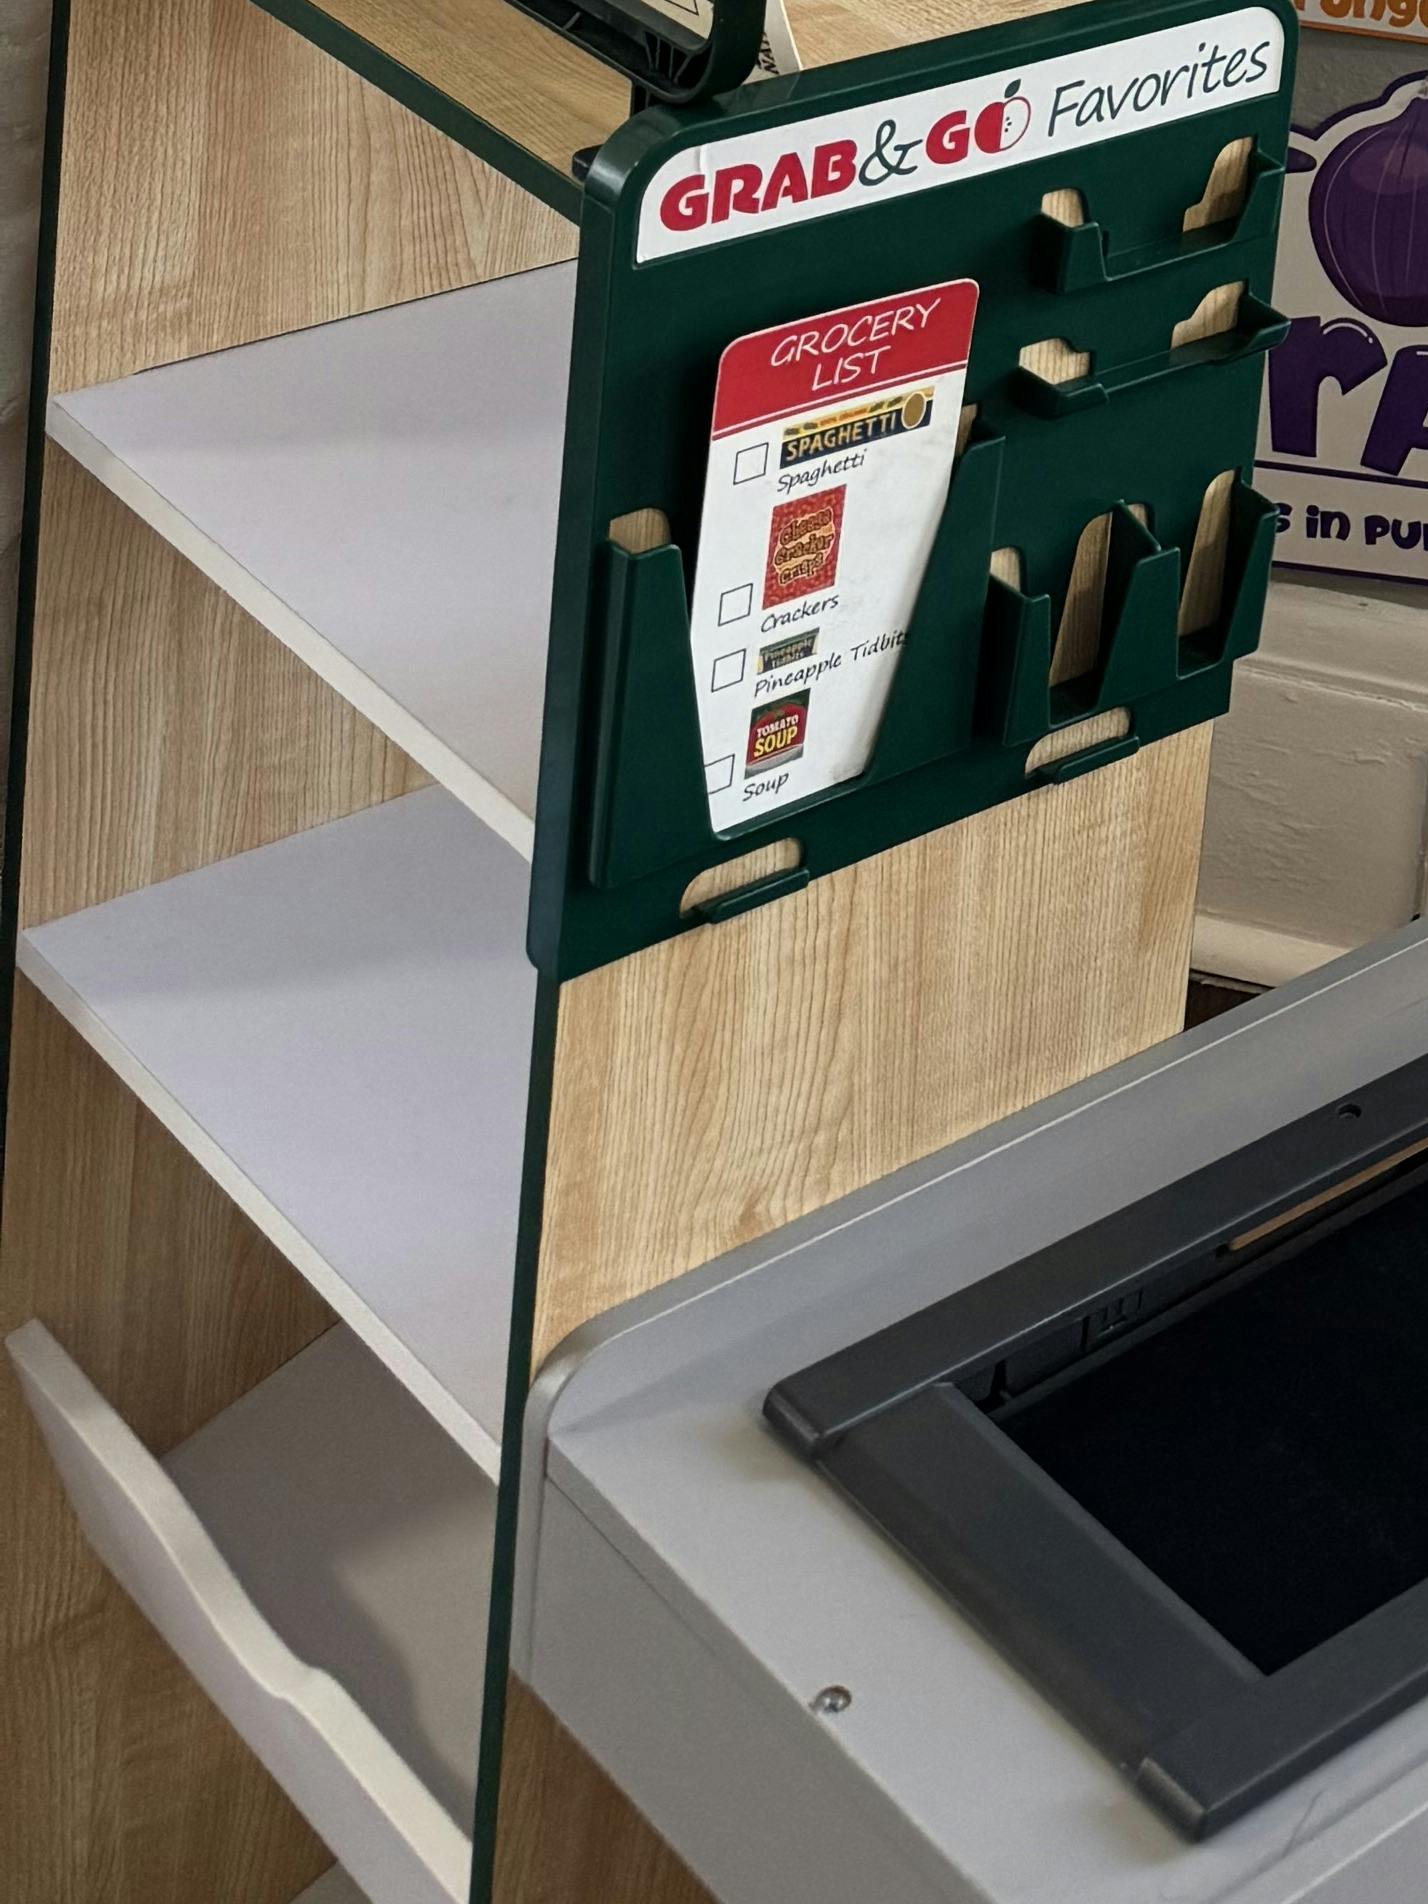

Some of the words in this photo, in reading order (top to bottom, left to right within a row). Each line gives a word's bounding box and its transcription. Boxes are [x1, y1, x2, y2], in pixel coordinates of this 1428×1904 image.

[1047, 38, 1270, 139] Favorites
[771, 298, 941, 367] GROCERY
[812, 346, 891, 391] LIST
[786, 413, 896, 461] SPAGHETTI
[777, 448, 868, 494] Spaghetti
[1305, 504, 1351, 542] in
[760, 595, 839, 633] Crackers
[754, 652, 842, 698] Pineapple
[850, 630, 908, 661] Tidbit
[753, 726, 798, 758] SOUP
[756, 714, 799, 739] TOMATO
[742, 773, 789, 802] Soup
